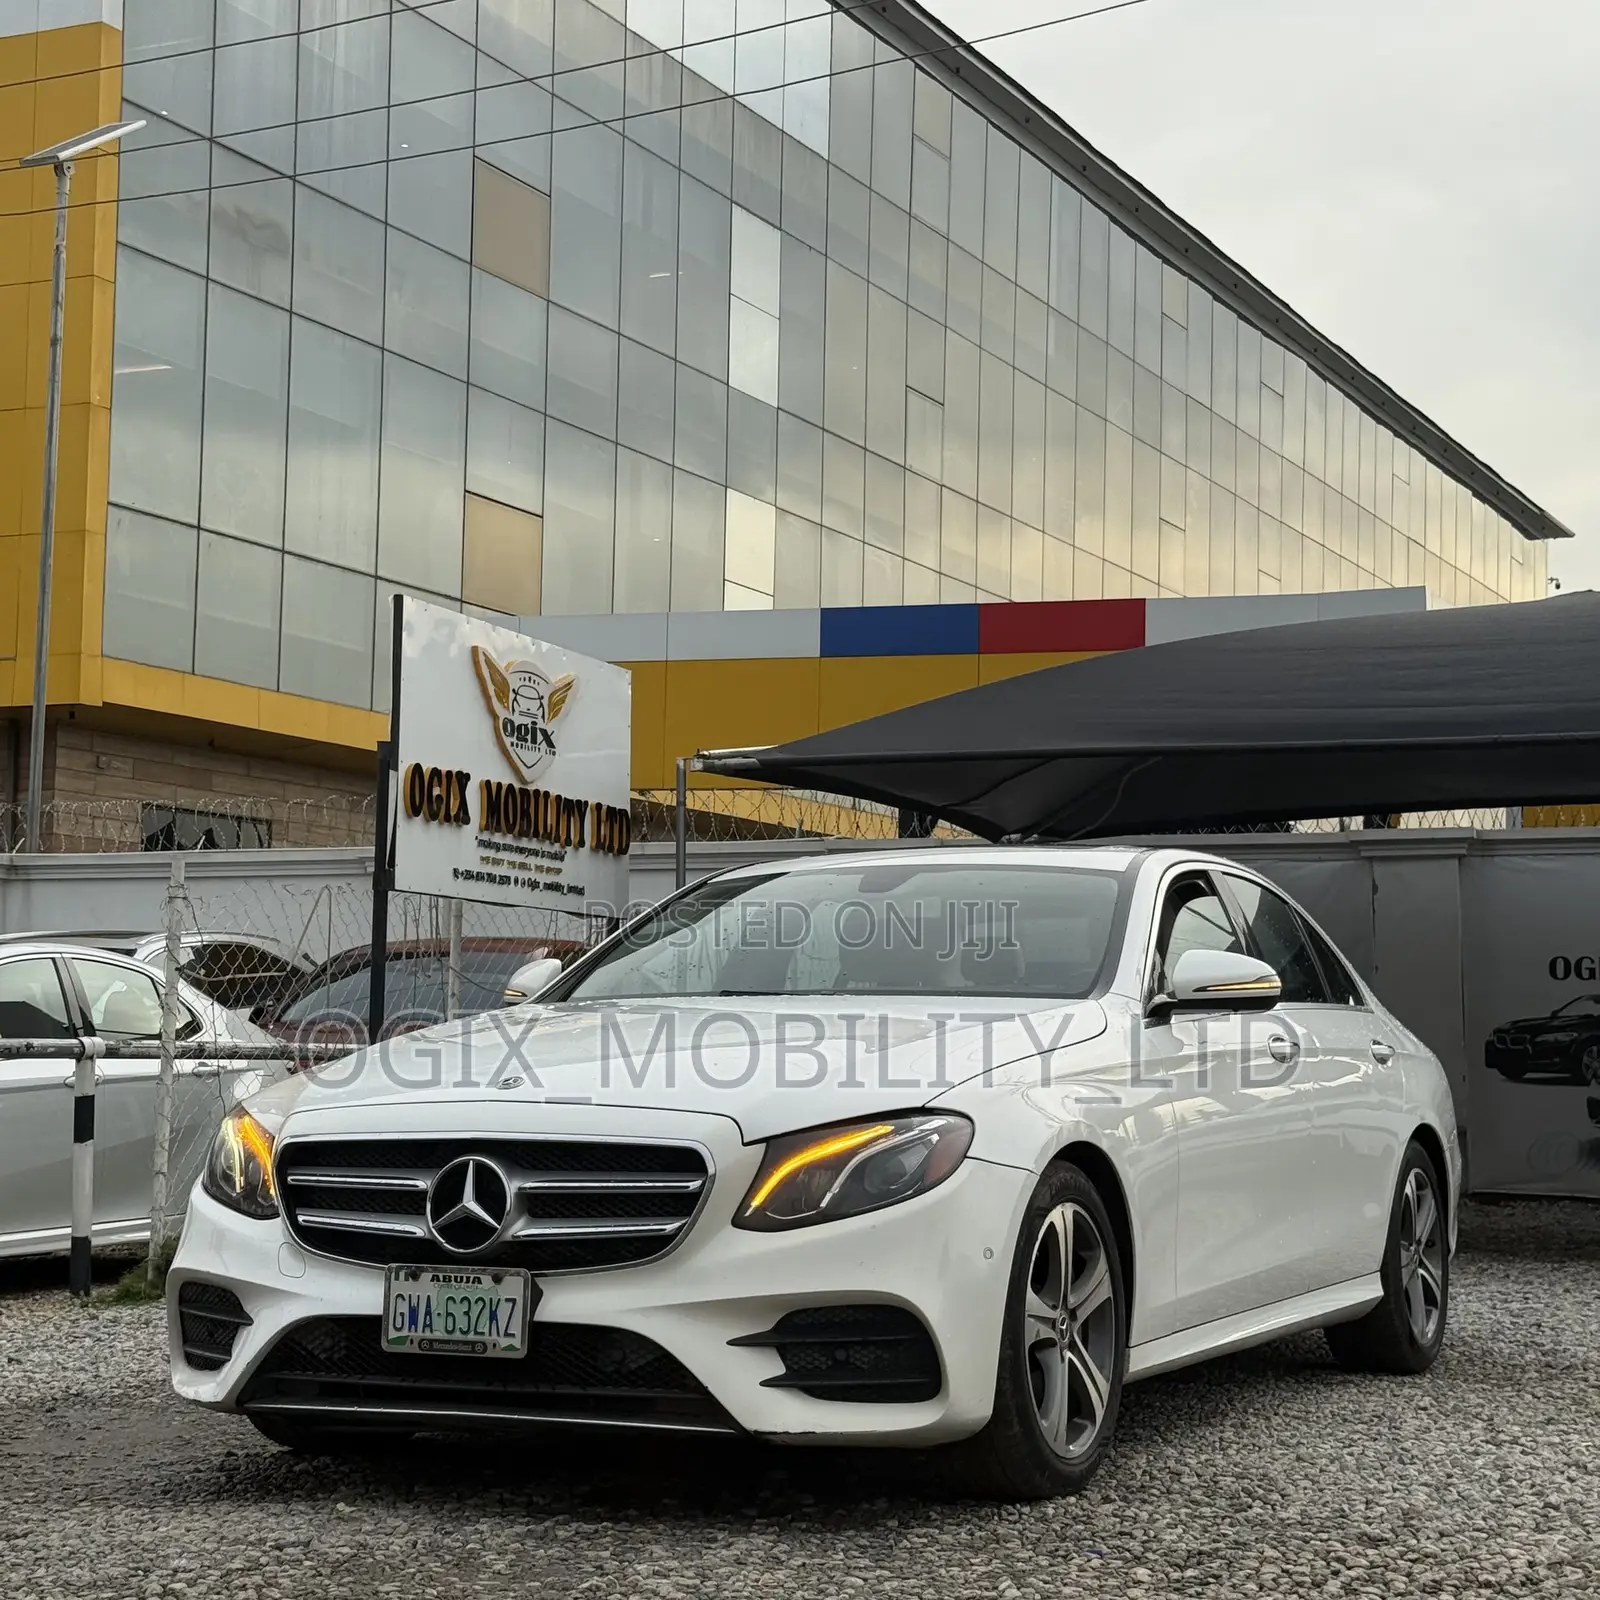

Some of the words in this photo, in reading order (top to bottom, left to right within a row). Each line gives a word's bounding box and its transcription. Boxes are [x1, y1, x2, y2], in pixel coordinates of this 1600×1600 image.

[510, 741, 541, 753] MOBILITY
[404, 763, 471, 826] OGIX
[479, 779, 588, 848] MOBILITY
[590, 802, 631, 855] LTD
[1548, 955, 1600, 981] OG
[429, 1274, 483, 1285] ABUJA
